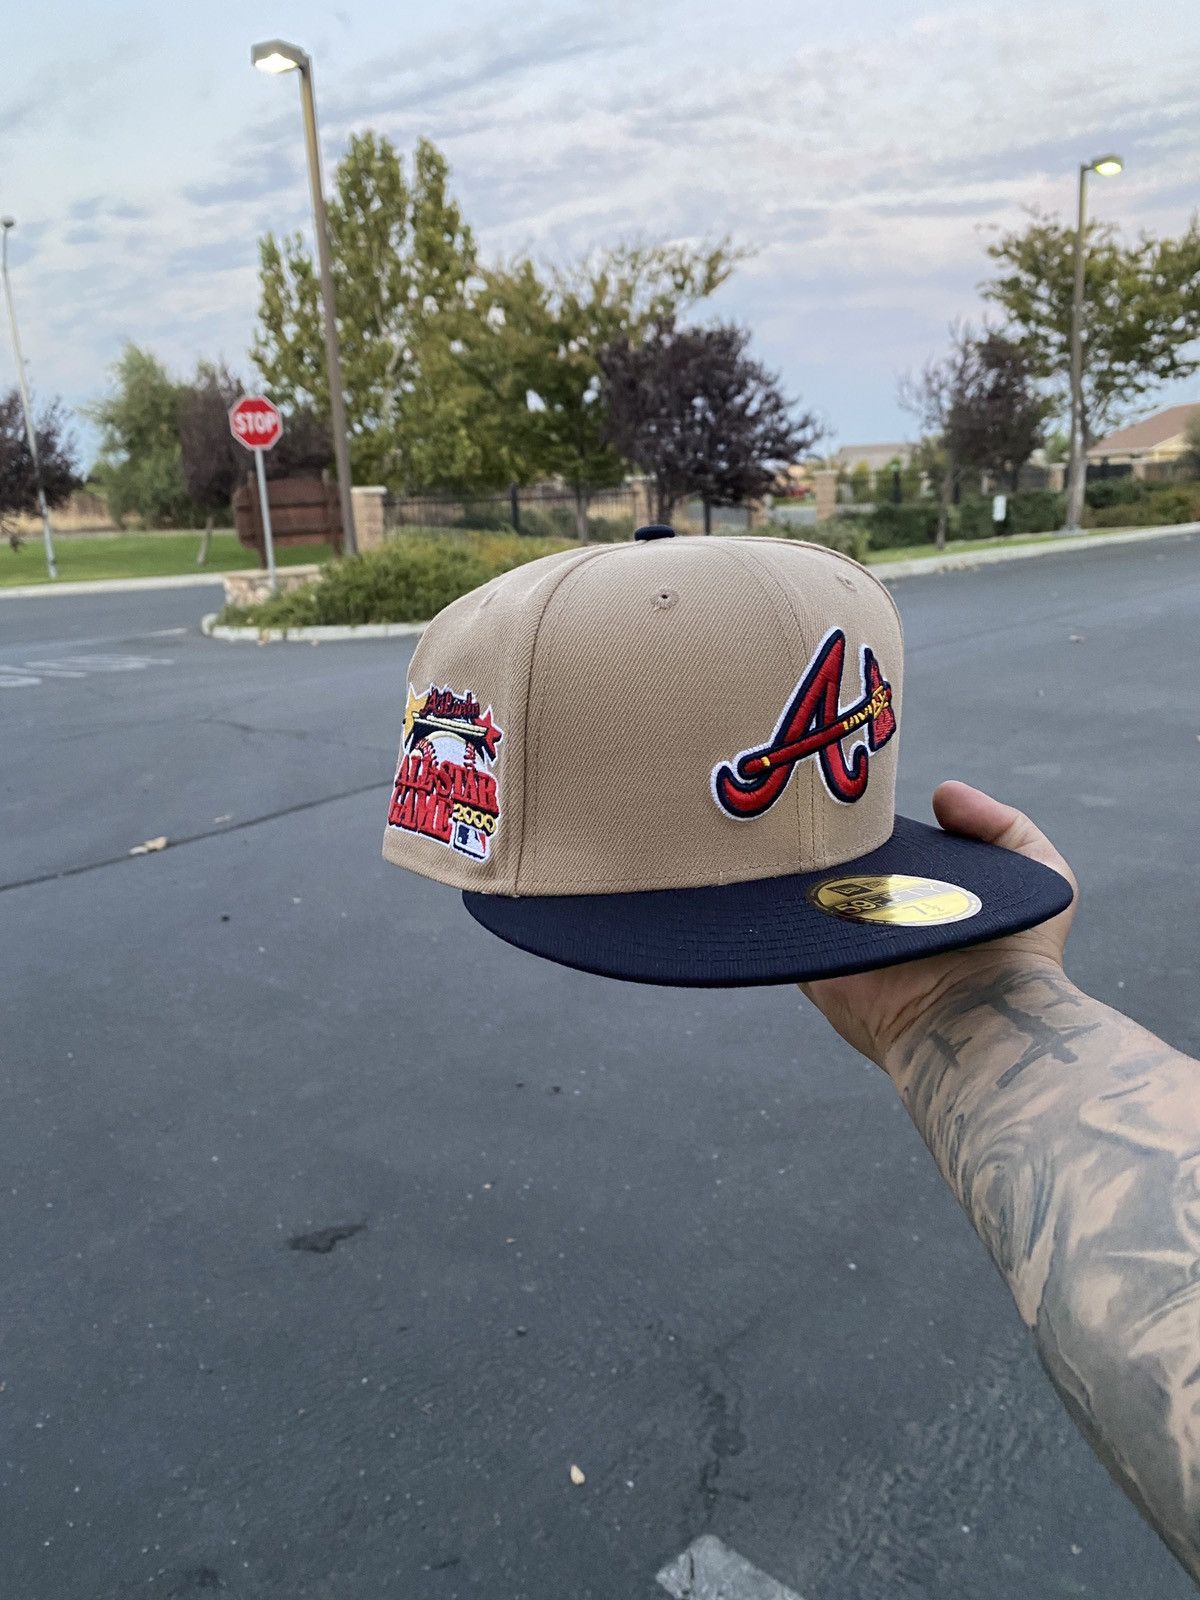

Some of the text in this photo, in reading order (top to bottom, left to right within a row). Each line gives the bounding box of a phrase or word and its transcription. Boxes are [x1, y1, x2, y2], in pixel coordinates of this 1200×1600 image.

[234, 411, 280, 435] STOP
[388, 785, 453, 844] GAME
[453, 803, 496, 834] 2000
